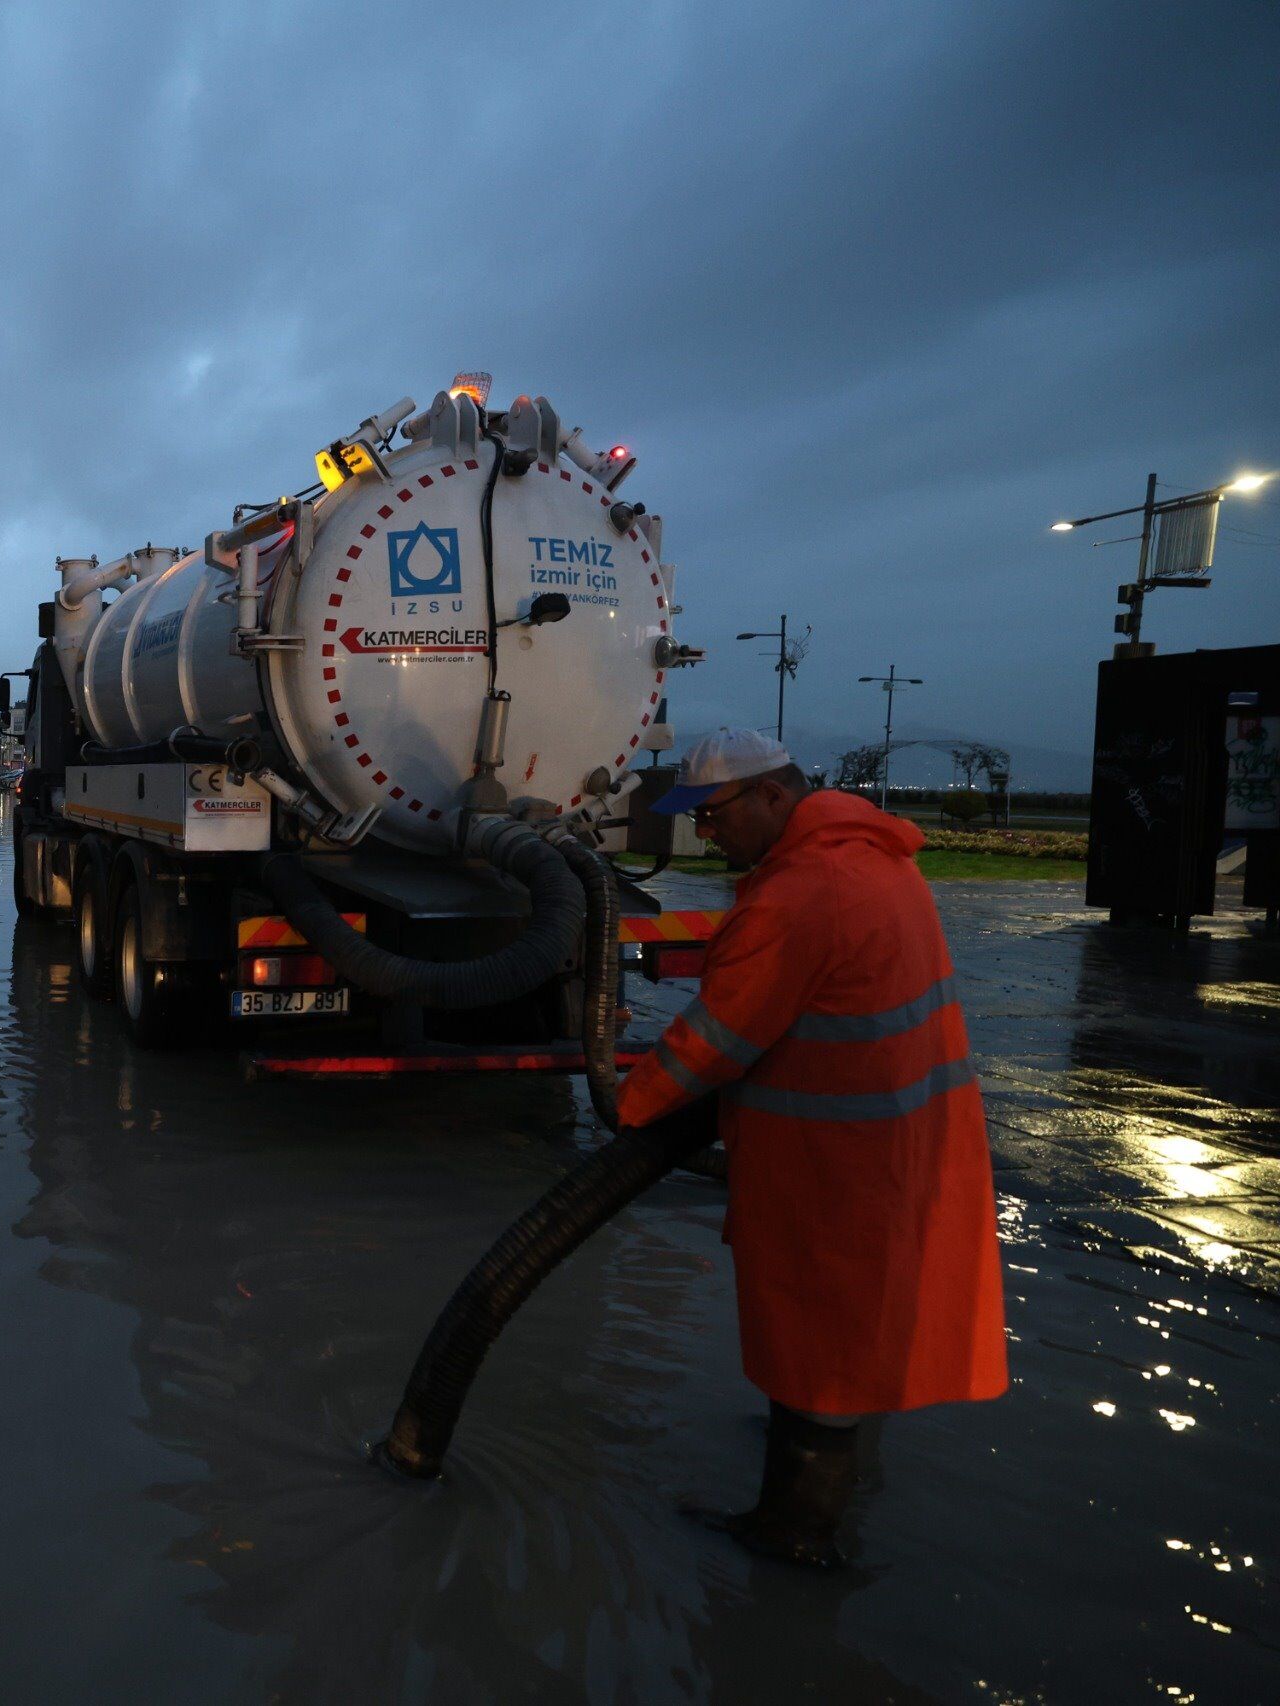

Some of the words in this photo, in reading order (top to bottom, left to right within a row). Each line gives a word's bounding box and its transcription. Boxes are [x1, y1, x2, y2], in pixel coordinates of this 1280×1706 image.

[528, 536, 614, 568] TEMİZ
[530, 564, 580, 585] izmir
[587, 568, 617, 592] için
[391, 600, 463, 615] İZSU
[364, 627, 487, 645] KATMERCİLER
[189, 769, 222, 792] CE
[243, 993, 263, 1013] 35
[272, 991, 304, 1012] BZJ
